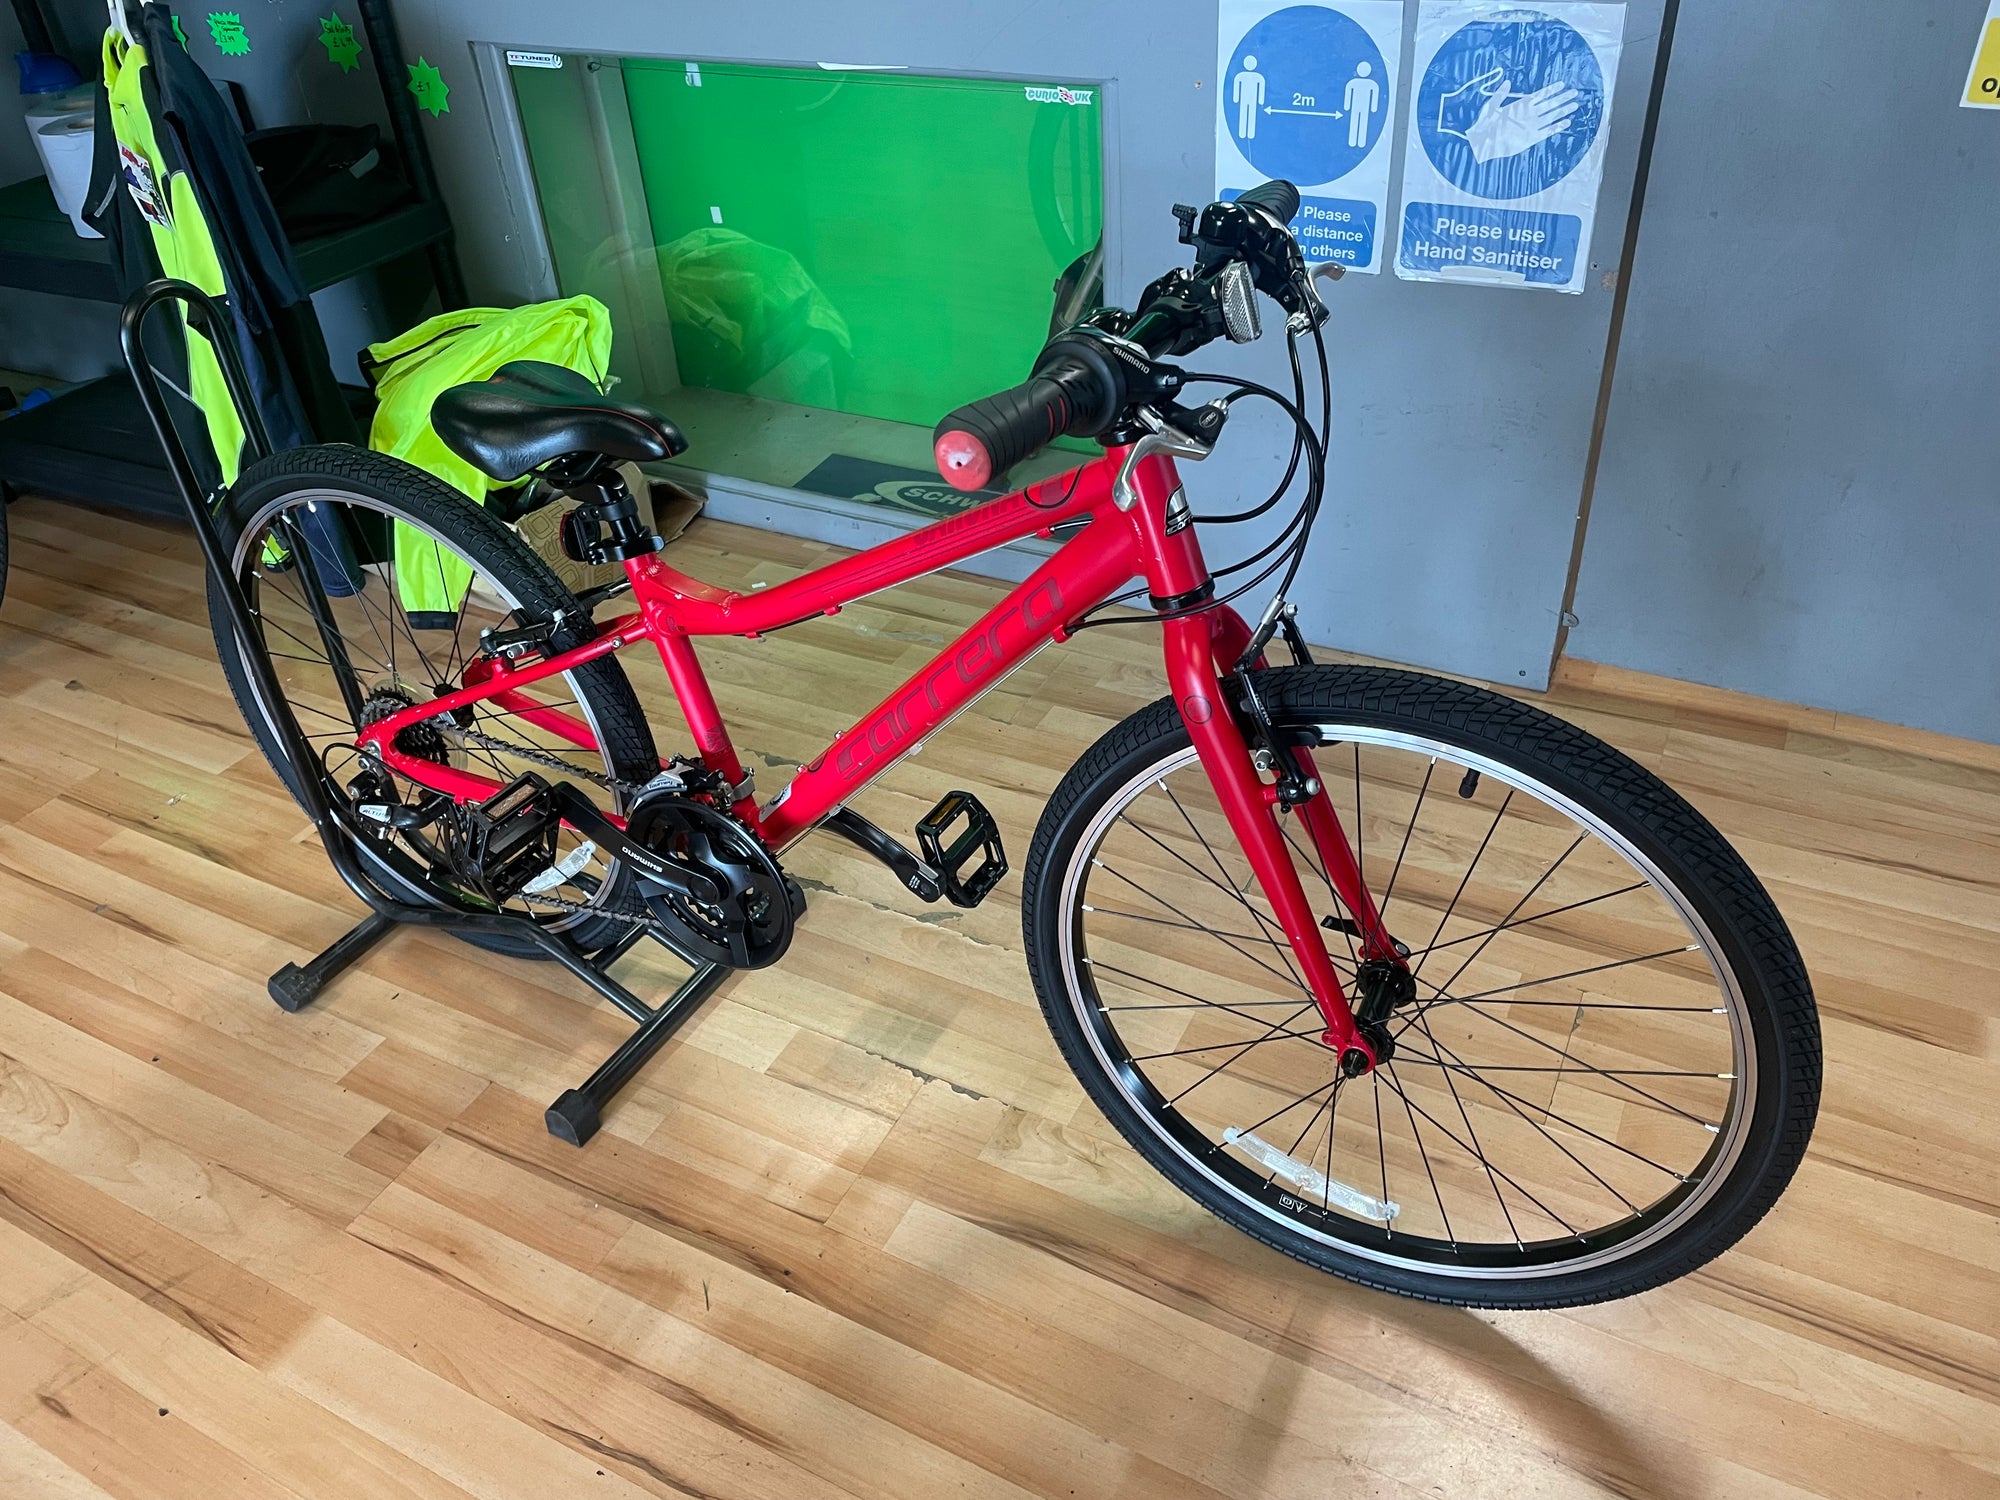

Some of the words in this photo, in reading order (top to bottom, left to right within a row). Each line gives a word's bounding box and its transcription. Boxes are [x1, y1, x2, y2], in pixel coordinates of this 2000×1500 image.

[1074, 92, 1089, 102] UK
[1292, 92, 1315, 107] 2m
[1304, 206, 1351, 222] Please
[1303, 225, 1364, 242] distance
[1436, 217, 1502, 239] Please
[1508, 227, 1545, 243] use
[1311, 244, 1356, 260] others
[1415, 240, 1466, 261] Hand
[1471, 246, 1562, 270] Sanitiser
[1112, 346, 1150, 375] SHIMANO
[903, 487, 981, 509] SCHW
[836, 576, 1066, 781] carrera
[621, 845, 663, 874] SHIMANO
